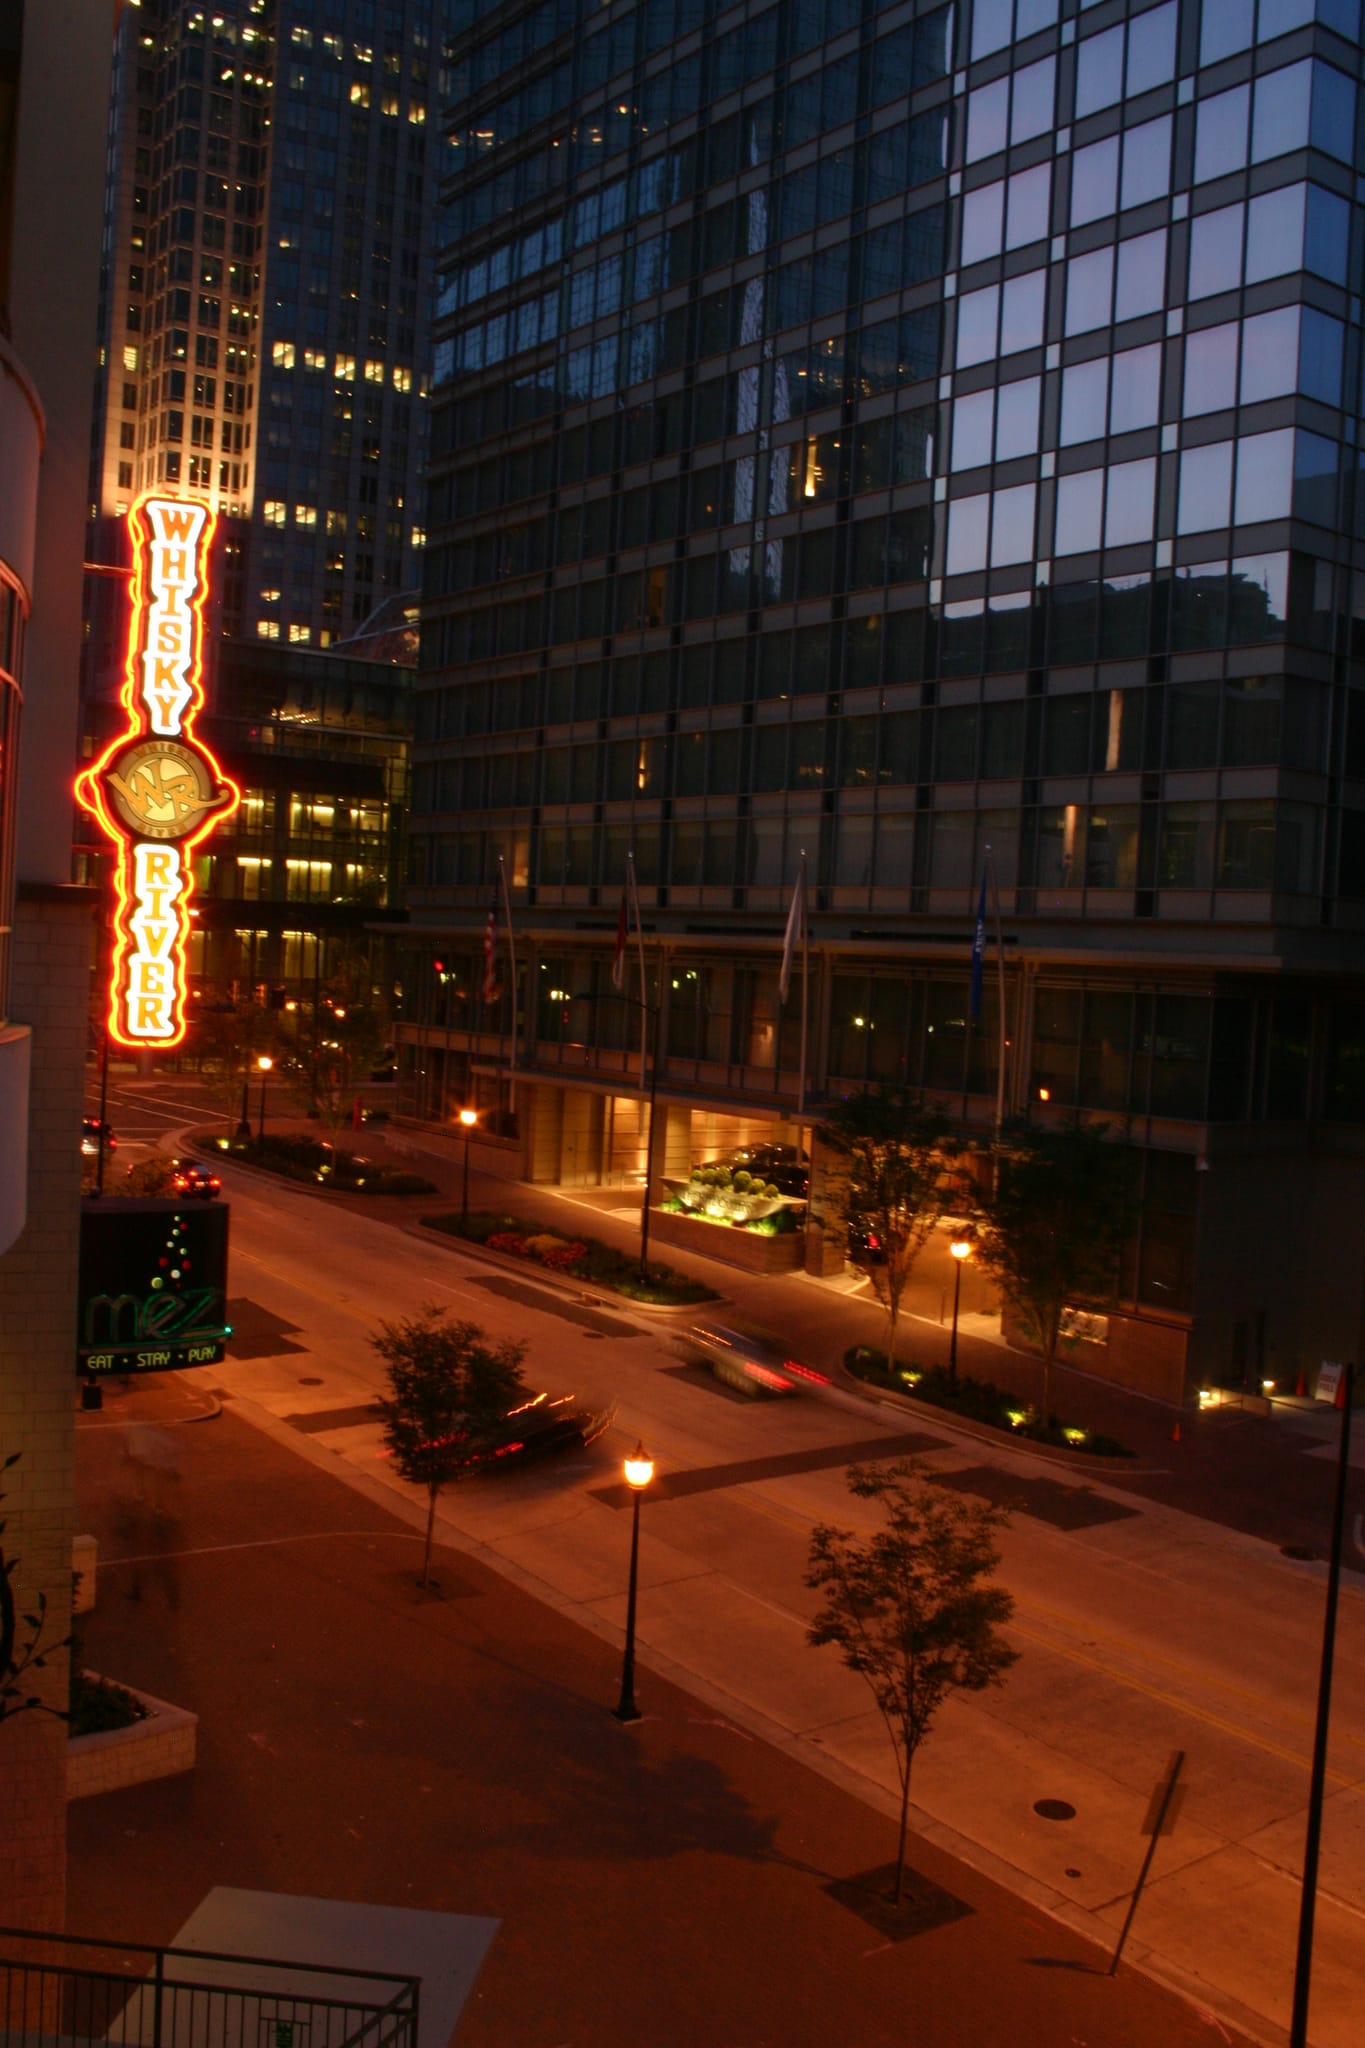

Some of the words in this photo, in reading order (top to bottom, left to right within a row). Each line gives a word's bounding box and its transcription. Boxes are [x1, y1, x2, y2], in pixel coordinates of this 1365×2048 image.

[153, 507, 196, 727] WHISKY
[136, 851, 172, 1030] RIVER
[87, 1355, 115, 1369] EAT
[136, 1351, 171, 1367] STAY
[188, 1346, 216, 1362] PLAY
